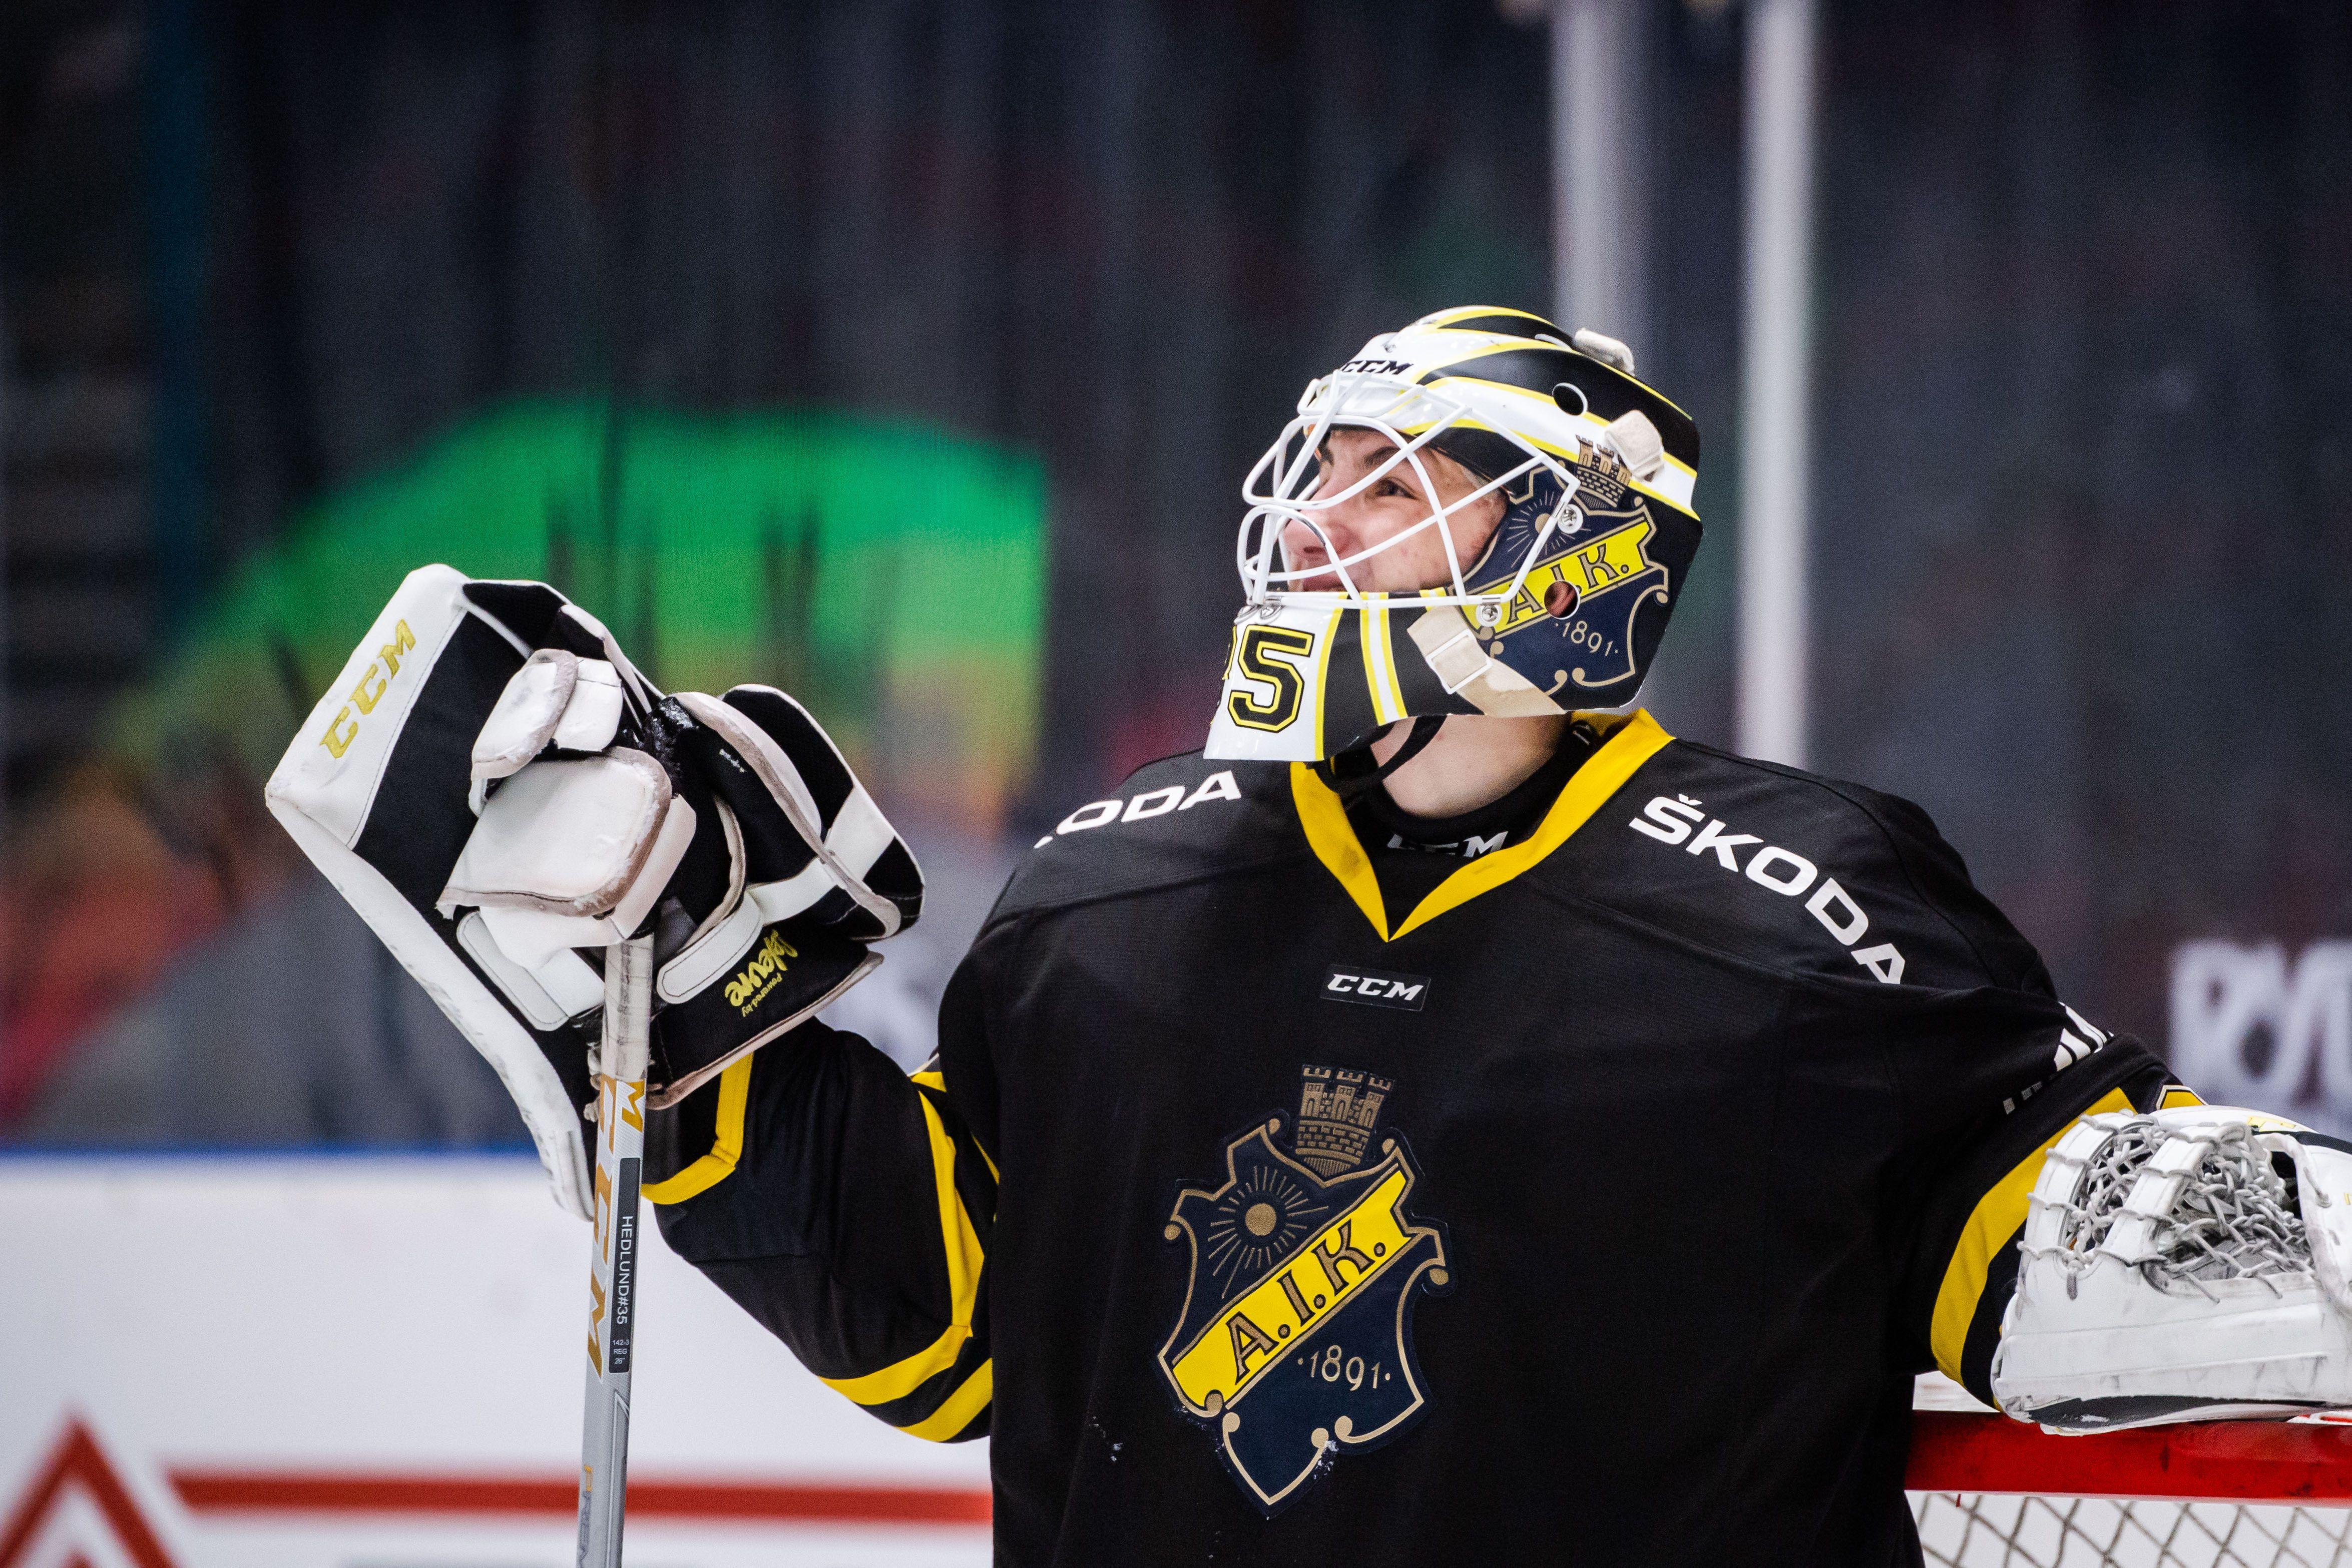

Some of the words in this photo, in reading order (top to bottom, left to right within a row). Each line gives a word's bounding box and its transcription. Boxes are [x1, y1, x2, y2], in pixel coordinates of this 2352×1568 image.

[1341, 360, 1414, 375] CCM
[319, 618, 416, 759] CCM
[1222, 624, 1315, 734] 5
[1033, 770, 1242, 849] ODA
[1629, 794, 1906, 985] ŠKODA
[1327, 974, 1424, 1000] CCM
[617, 1216, 633, 1325] HEDLUND#35
[1226, 1218, 1386, 1385] A.I.K.
